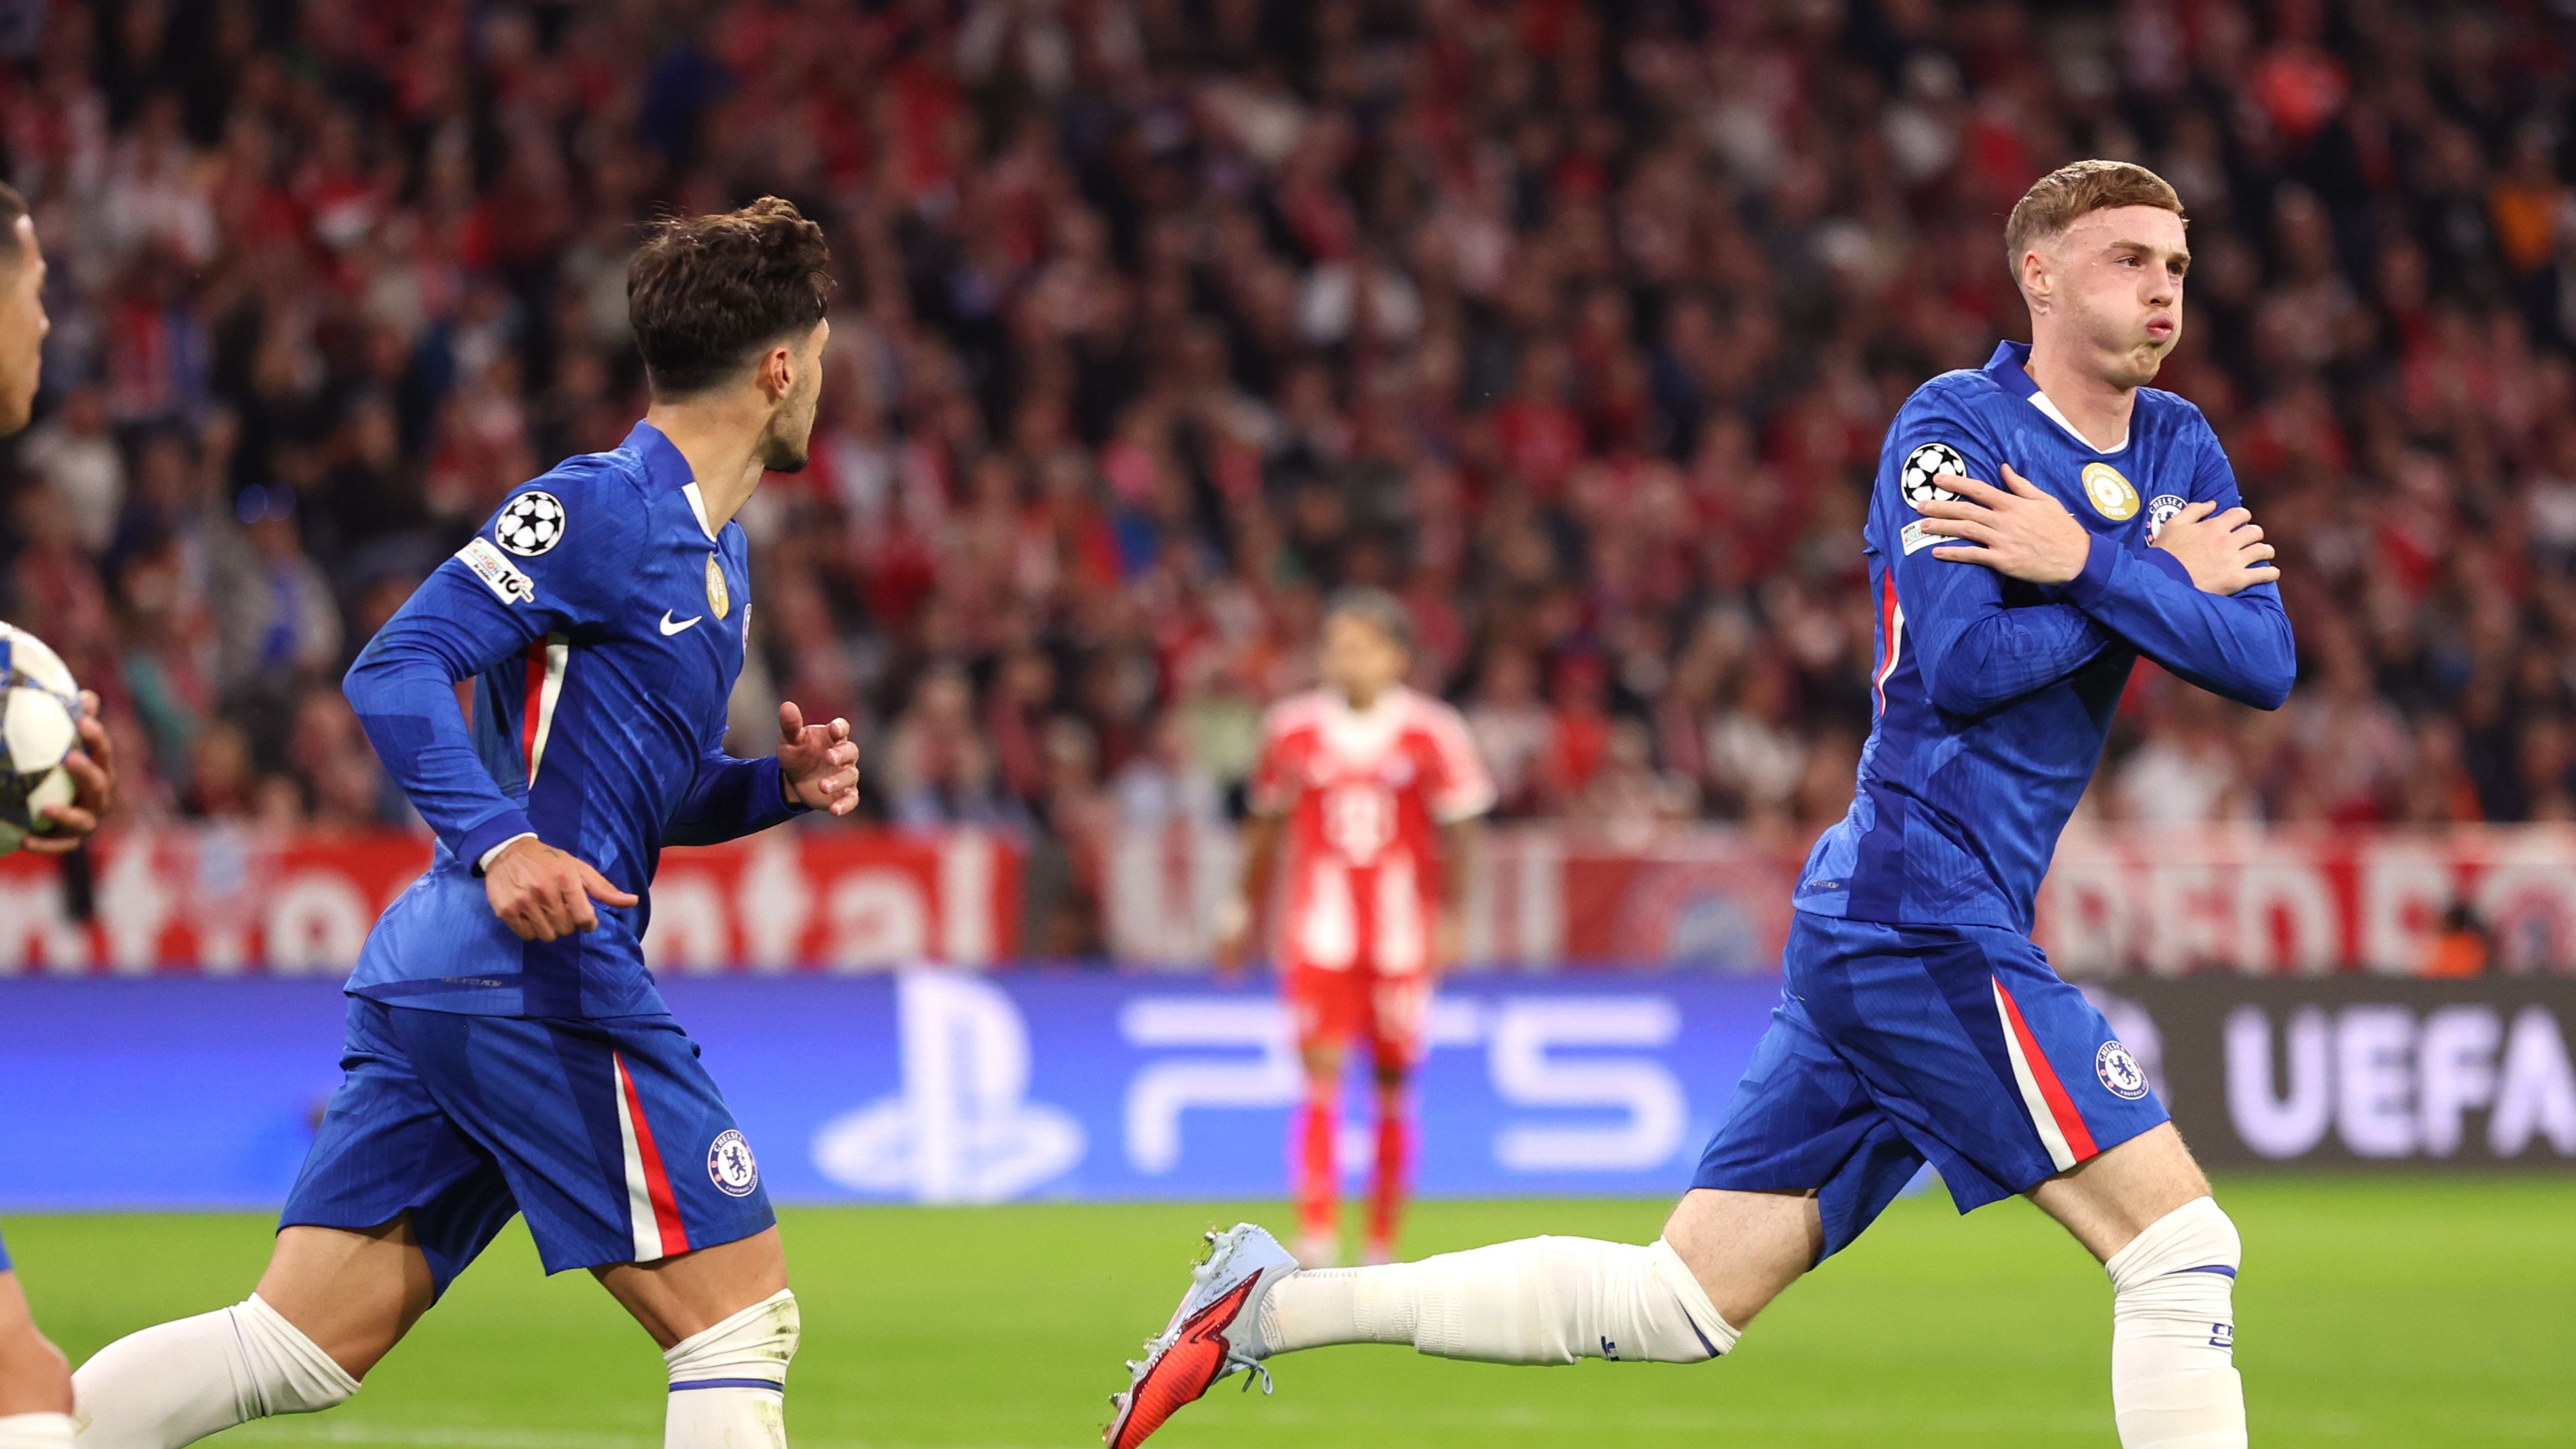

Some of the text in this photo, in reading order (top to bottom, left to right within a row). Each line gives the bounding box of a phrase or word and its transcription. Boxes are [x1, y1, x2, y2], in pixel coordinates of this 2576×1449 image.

[2104, 507, 2128, 516] FIFA
[2149, 497, 2183, 514] CHELSEA
[2099, 1043, 2126, 1061] CHELSEA
[2223, 1004, 2576, 1159] UEFA
[713, 1132, 743, 1152] CHELSEA
